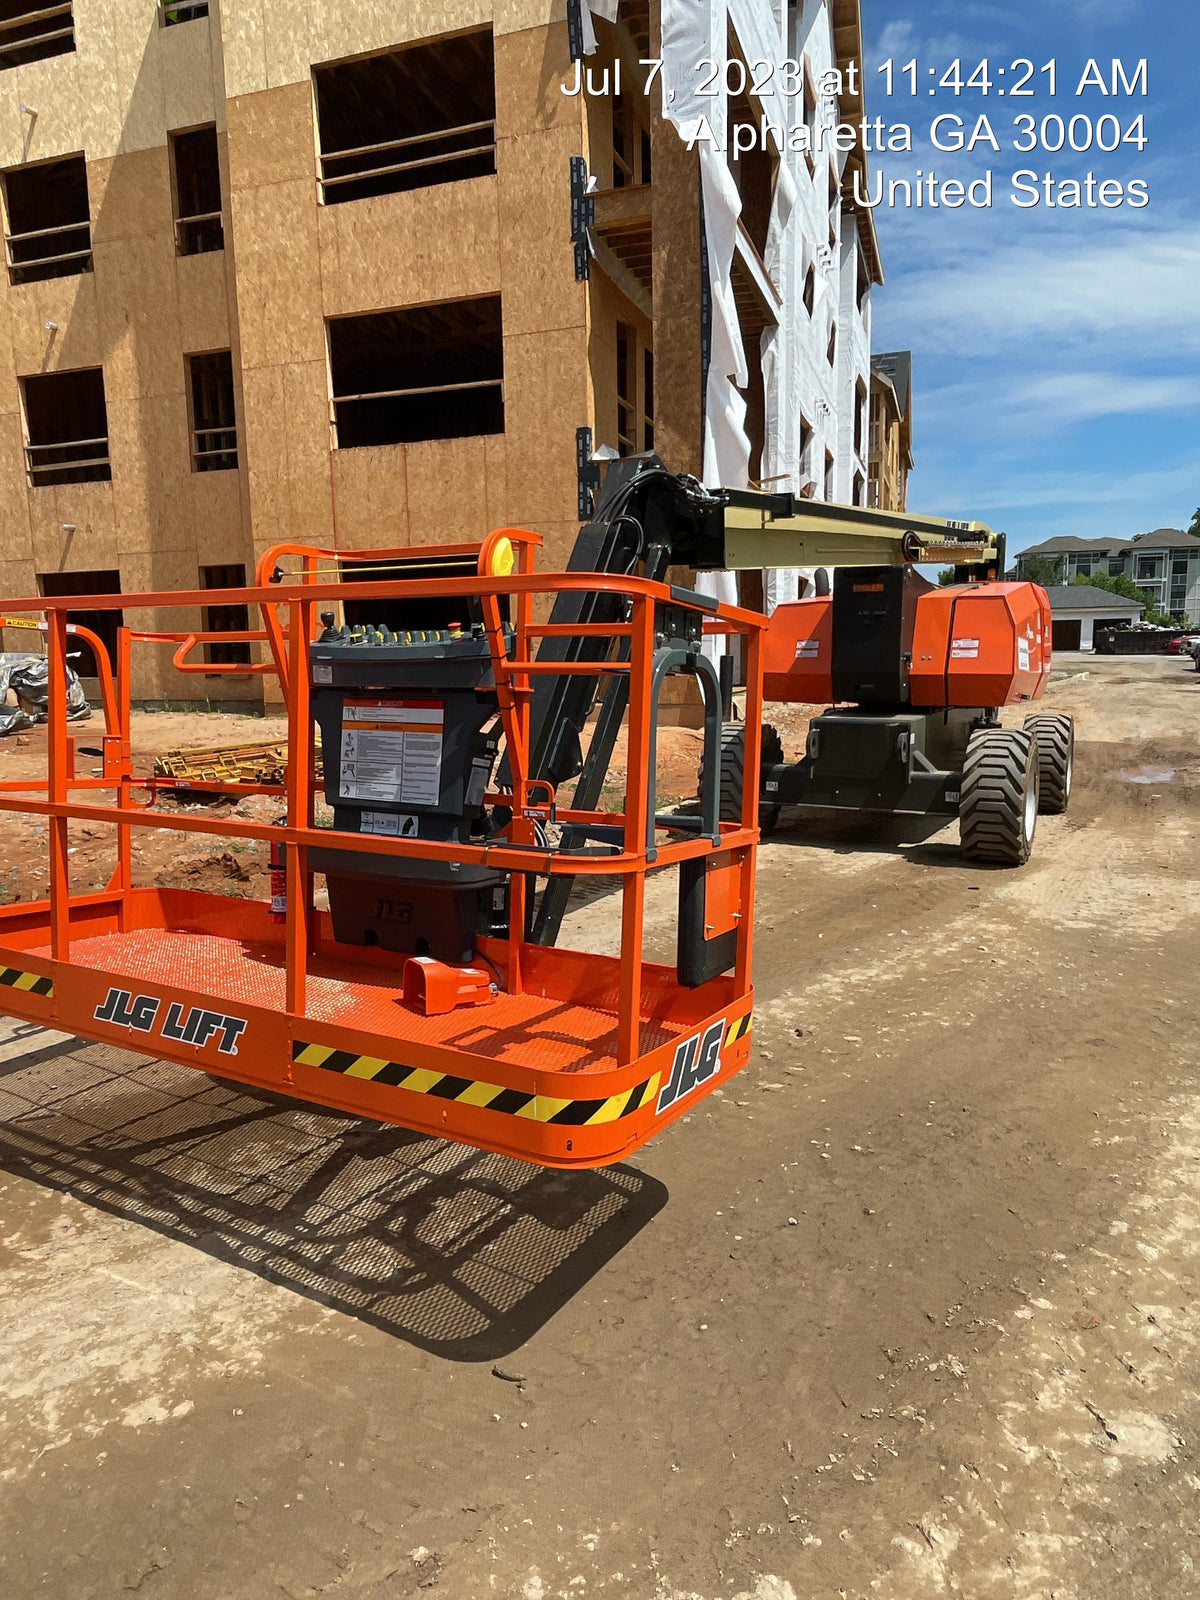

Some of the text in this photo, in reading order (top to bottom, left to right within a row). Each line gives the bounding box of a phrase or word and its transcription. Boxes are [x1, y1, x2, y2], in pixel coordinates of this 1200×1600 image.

[12, 620, 37, 628] CAUTION
[93, 988, 248, 1055] JLG LIFT
[655, 1016, 727, 1116] JLG
